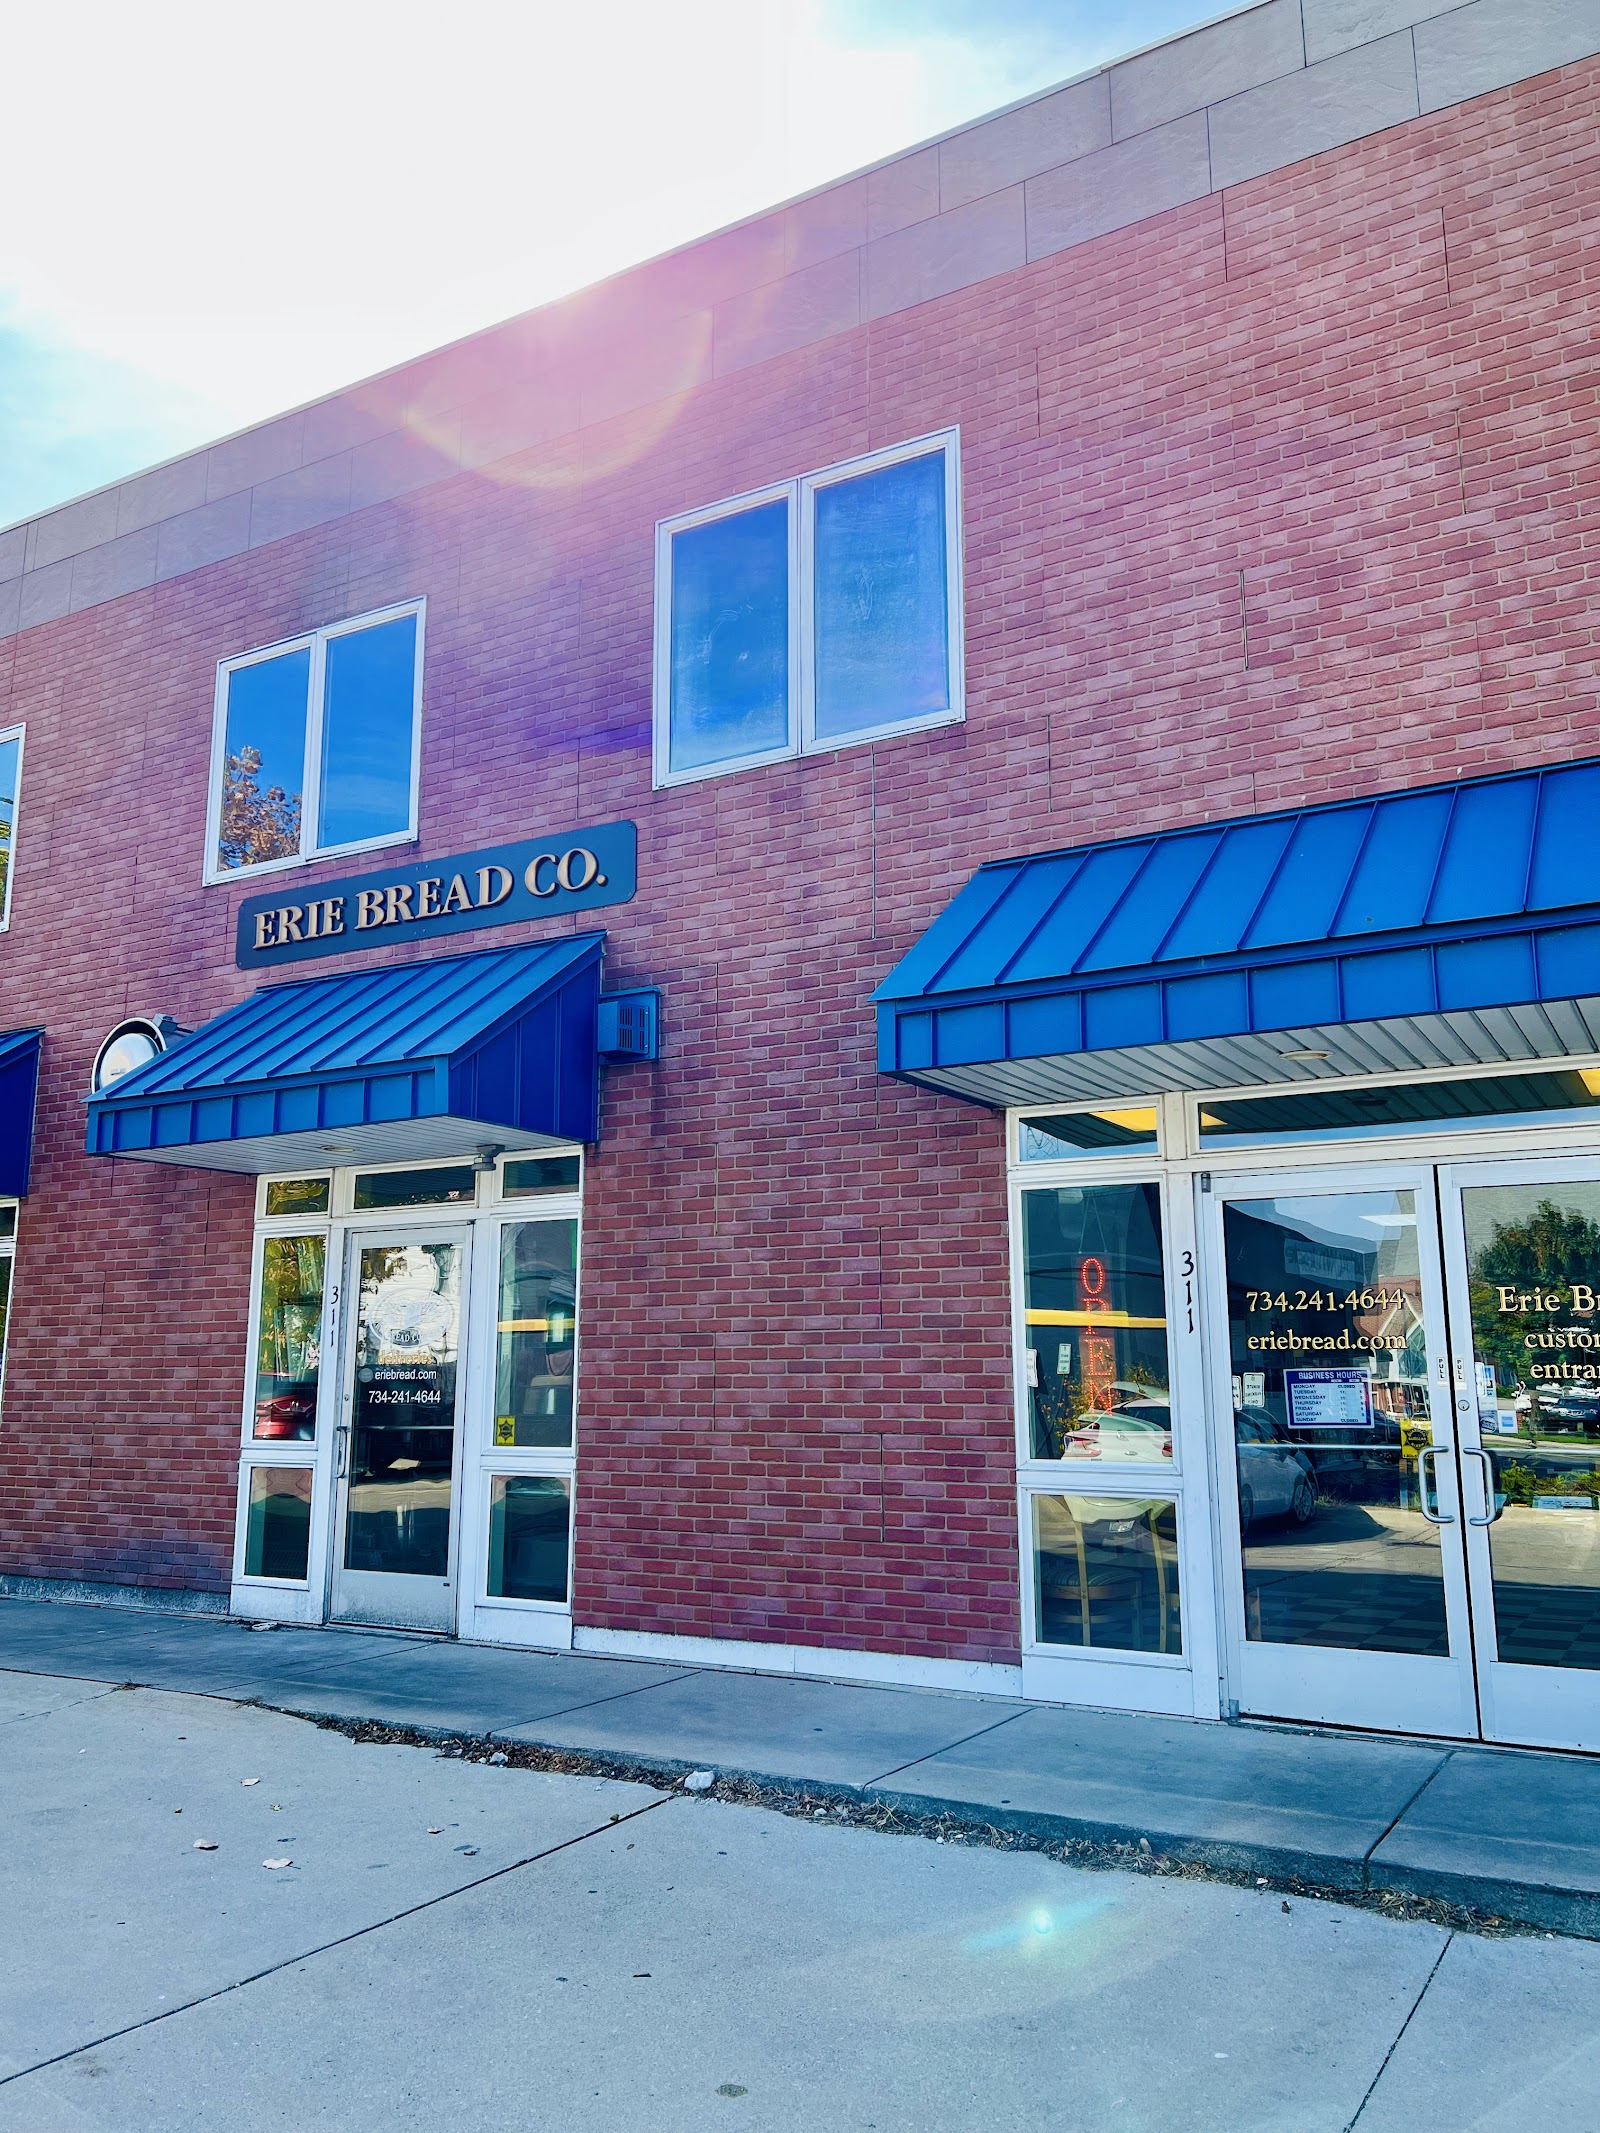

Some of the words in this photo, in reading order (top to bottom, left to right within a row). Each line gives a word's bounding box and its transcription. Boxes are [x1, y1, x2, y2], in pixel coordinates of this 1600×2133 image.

[252, 897, 346, 950] ERIE
[354, 865, 514, 931] BREAD
[524, 848, 608, 896] CO.
[1181, 1250, 1195, 1334] 311
[1246, 1288, 1405, 1313] 734.241.4644
[1495, 1286, 1561, 1312] Erie
[330, 1285, 339, 1348] 311
[1081, 1257, 1114, 1418] OPEN
[1247, 1328, 1408, 1350] eriebread.com
[1524, 1331, 1600, 1348] custo
[374, 1368, 437, 1380] eriebread.com
[1298, 1371, 1335, 1380] BUSINESS
[1336, 1370, 1362, 1379] HOURS
[1530, 1361, 1600, 1379] entra
[368, 1390, 442, 1404] 734-241-4644
